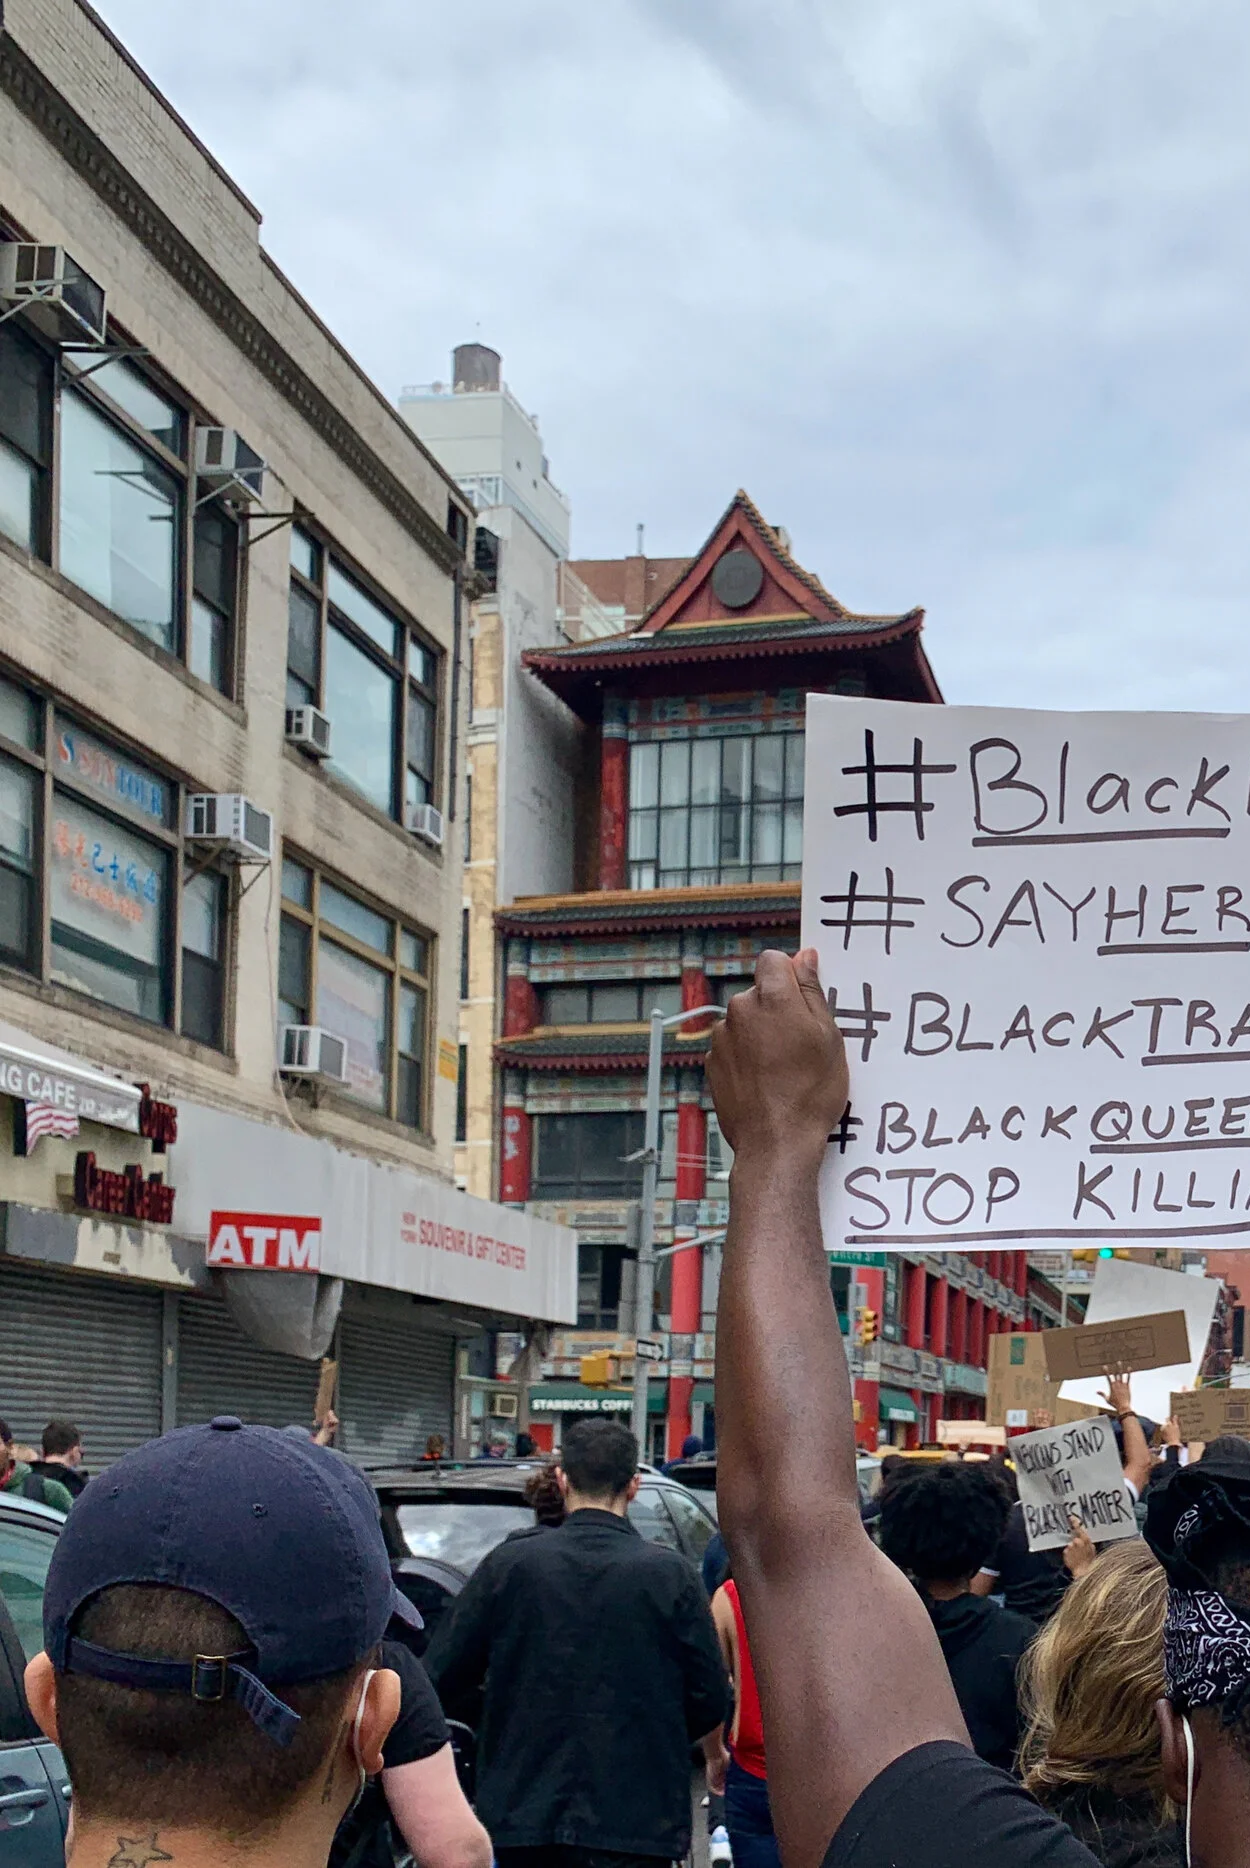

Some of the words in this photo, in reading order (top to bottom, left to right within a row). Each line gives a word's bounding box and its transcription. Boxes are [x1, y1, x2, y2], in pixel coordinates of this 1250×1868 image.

[28, 1072, 77, 1110] CAFE
[844, 1166, 1020, 1230] STOP
[207, 1223, 320, 1269] ATM
[419, 1219, 466, 1255] SOUVENIR
[475, 1234, 494, 1261] GIFT
[495, 1240, 526, 1269] CENTER
[532, 1399, 600, 1411] STARBUCKS
[601, 1399, 634, 1411] COFF
[1063, 1426, 1105, 1460] STAND
